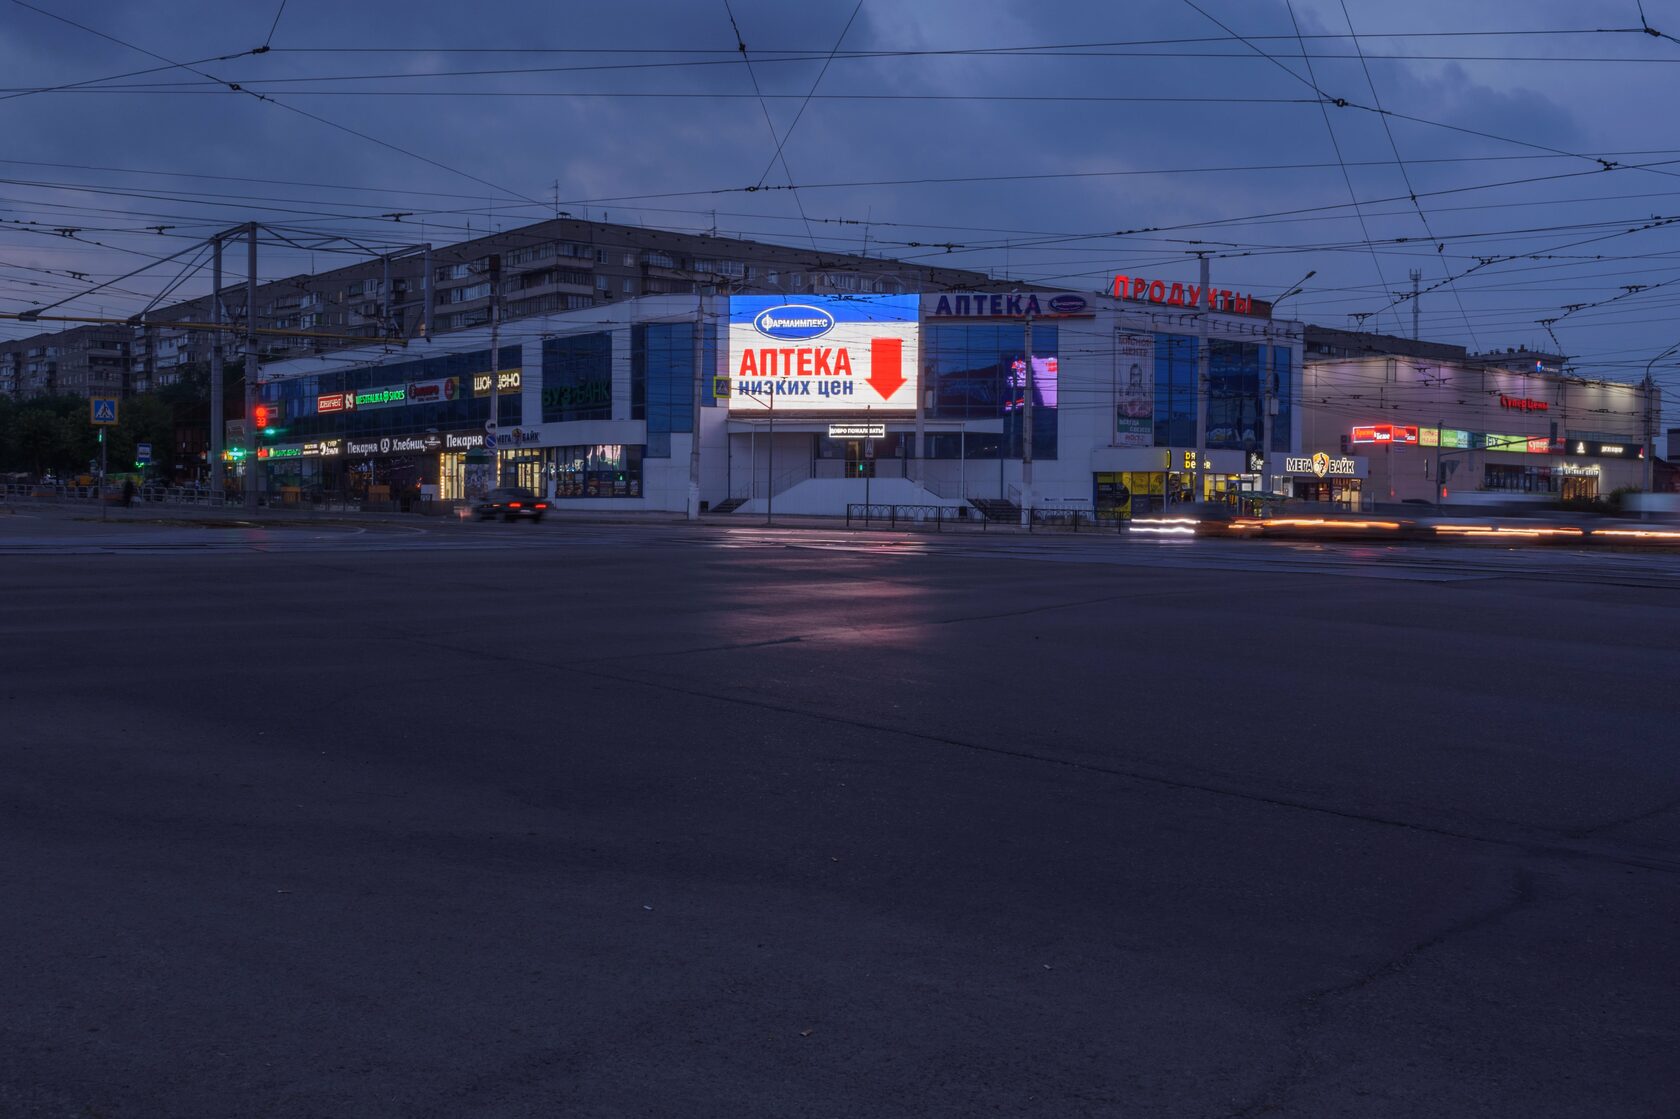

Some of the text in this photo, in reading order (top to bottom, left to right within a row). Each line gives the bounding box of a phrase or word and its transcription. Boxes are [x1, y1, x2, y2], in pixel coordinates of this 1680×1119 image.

[935, 294, 1041, 315] АПТЕКА
[739, 348, 852, 376] АПТЕКА
[739, 380, 853, 398] низких цен
[347, 442, 378, 456] Пекарня
[446, 434, 483, 449] Пекарня
[1286, 457, 1355, 474] МЕГА БАЙК
